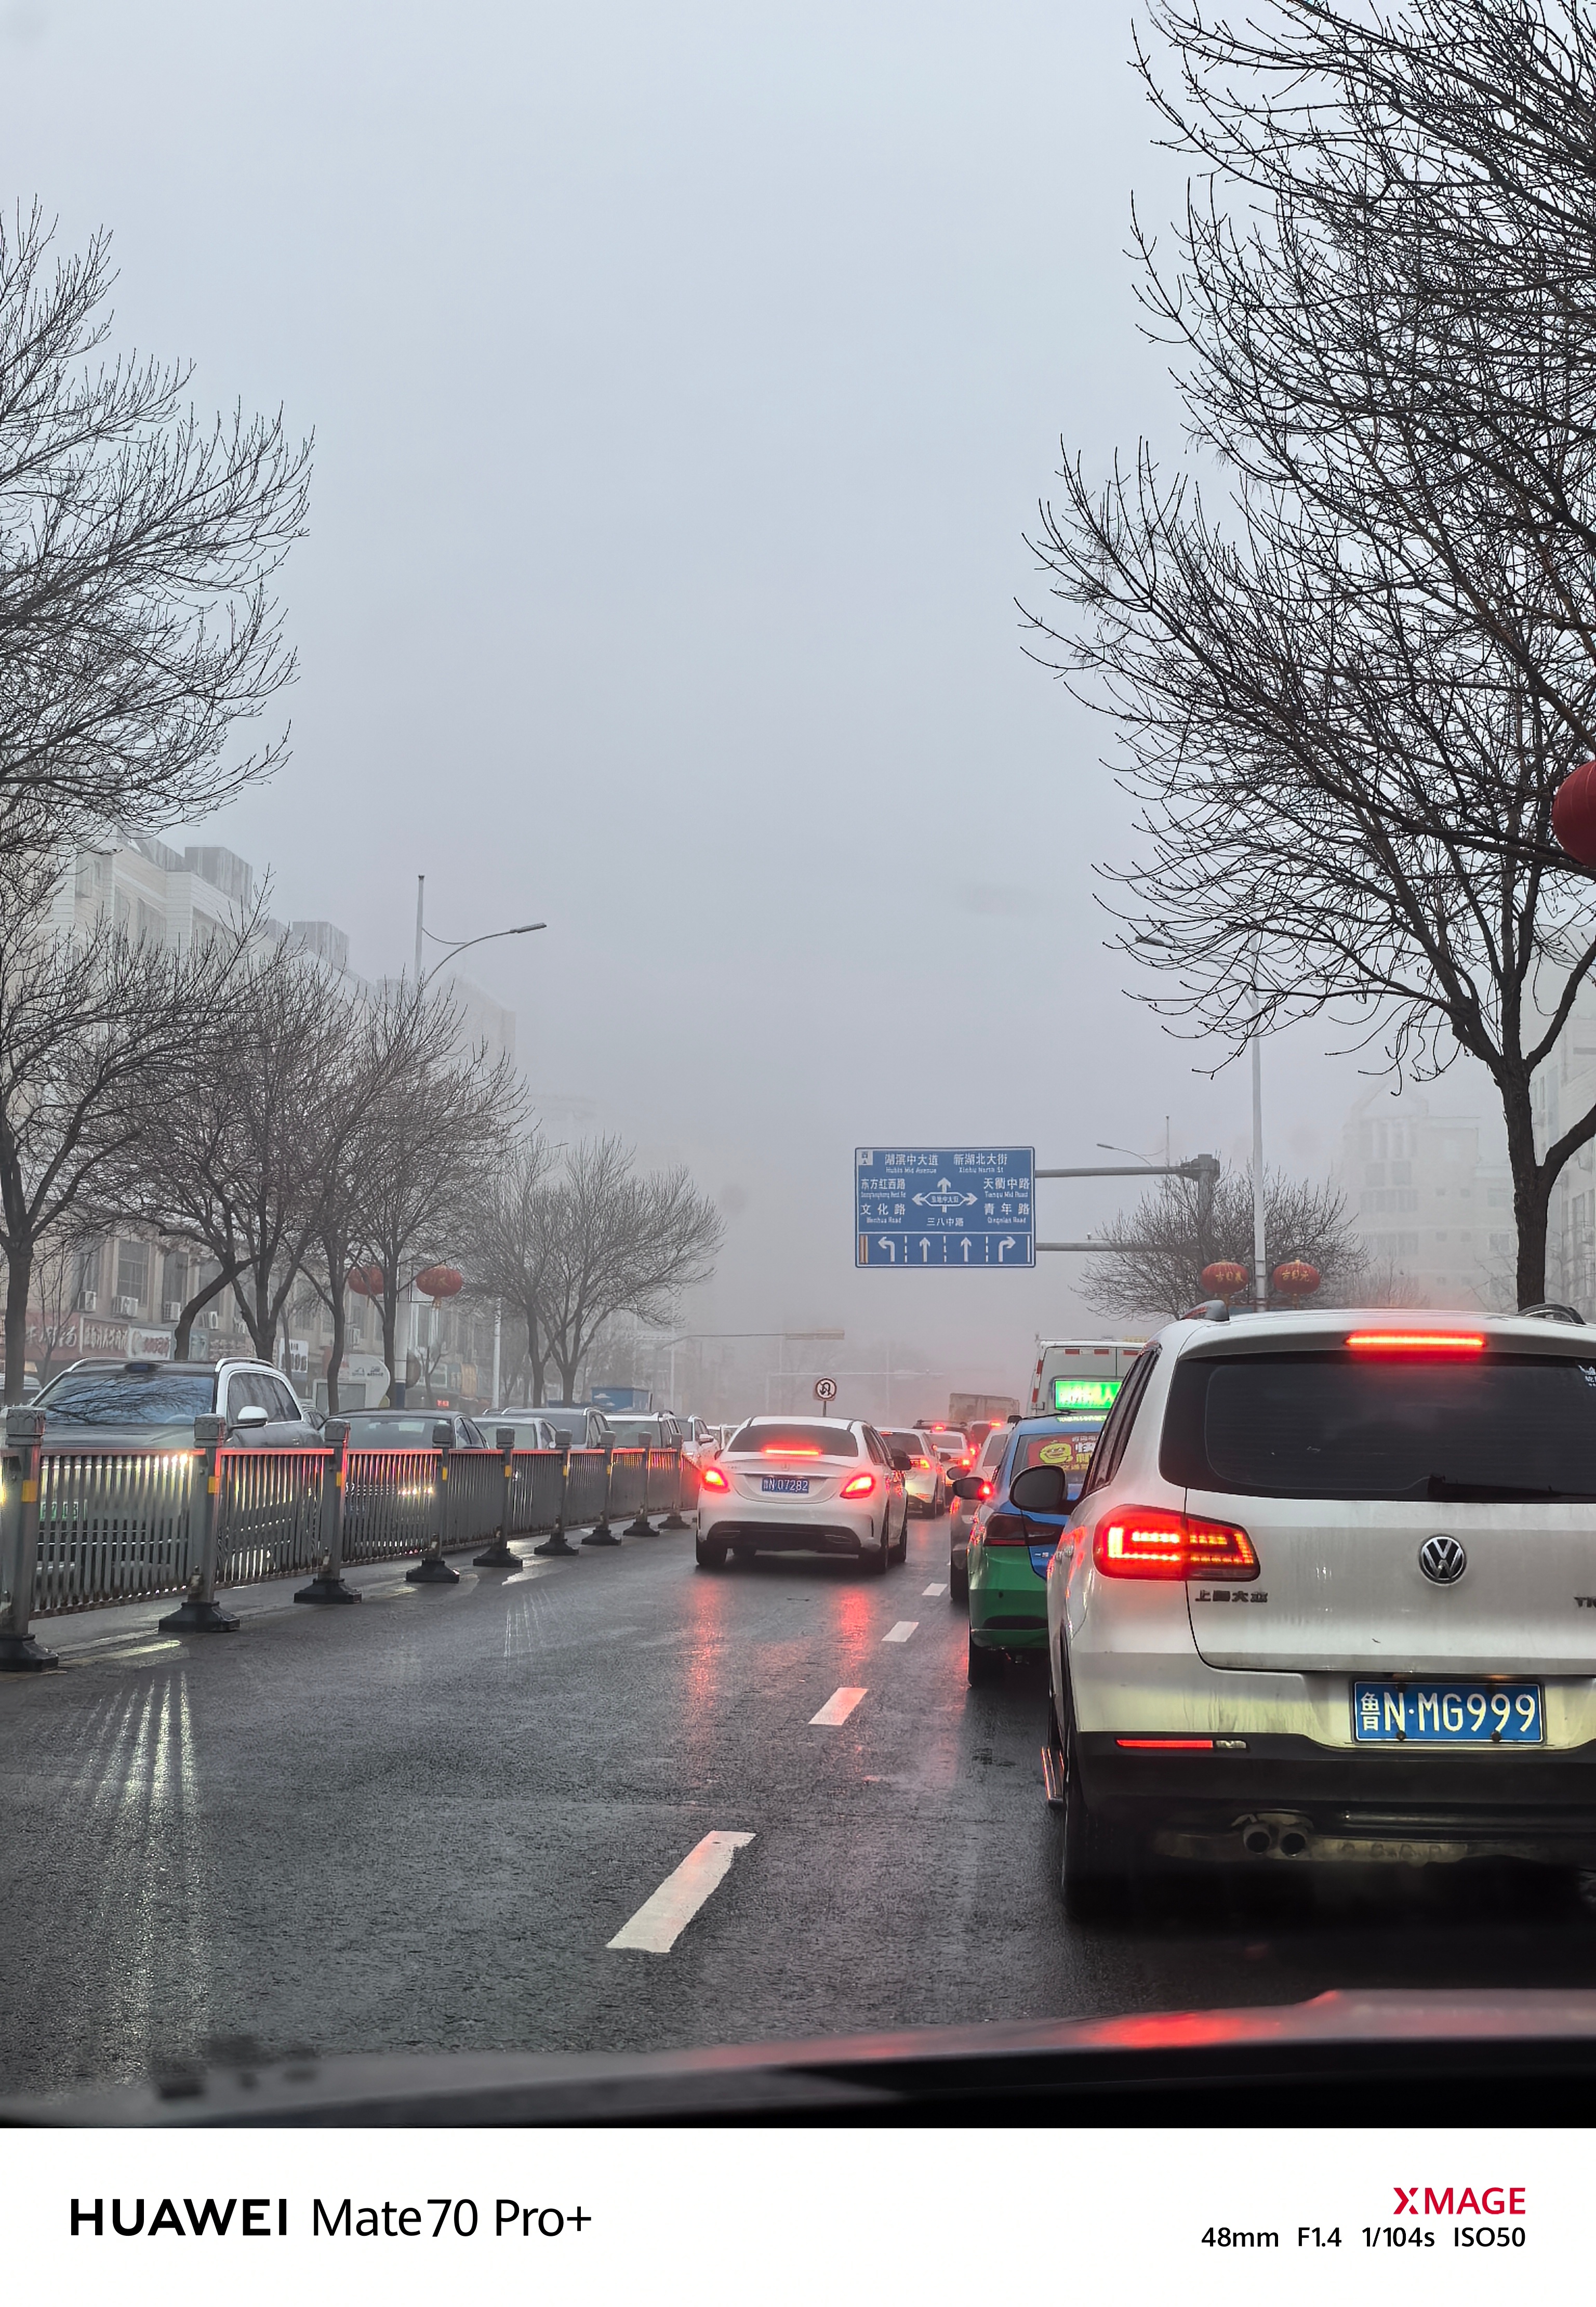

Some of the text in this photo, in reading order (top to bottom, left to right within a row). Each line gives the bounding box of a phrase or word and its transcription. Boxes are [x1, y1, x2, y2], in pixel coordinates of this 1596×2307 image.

[885, 1154, 938, 1165] 湖滨中大道
[953, 1153, 1007, 1165] 新湖北大街
[861, 1178, 906, 1189] 东方红西路
[983, 1177, 1030, 1189] 天衢中路
[860, 1203, 906, 1215] 文化路
[984, 1203, 1030, 1215] 青年路
[926, 1217, 964, 1226] 三八中路
[1360, 1691, 1536, 1733] 鲁N·MG999
